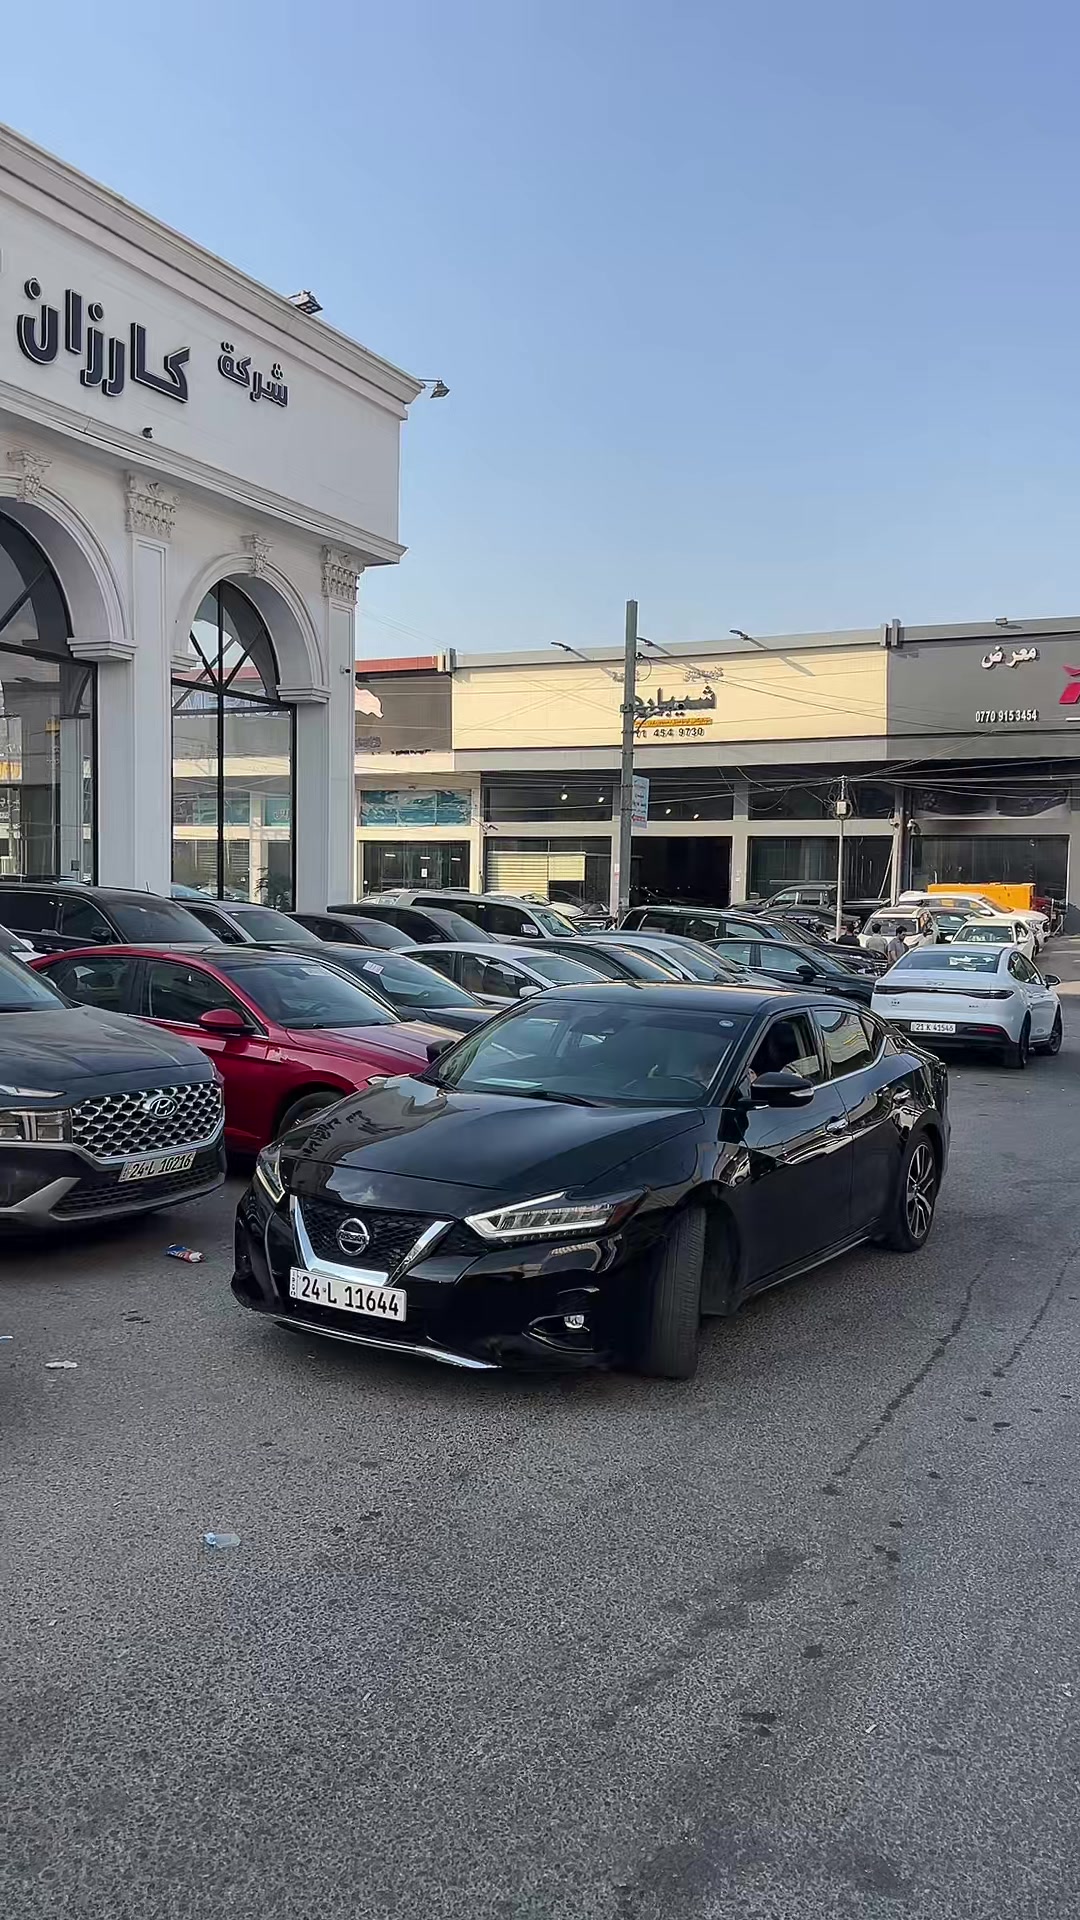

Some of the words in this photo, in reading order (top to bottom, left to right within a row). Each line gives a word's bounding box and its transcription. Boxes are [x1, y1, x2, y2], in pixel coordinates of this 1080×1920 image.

[16, 277, 190, 403] كارزان
[218, 341, 288, 407] شركة
[158, 1154, 193, 1173] 10216
[344, 1286, 399, 1316] 11644
